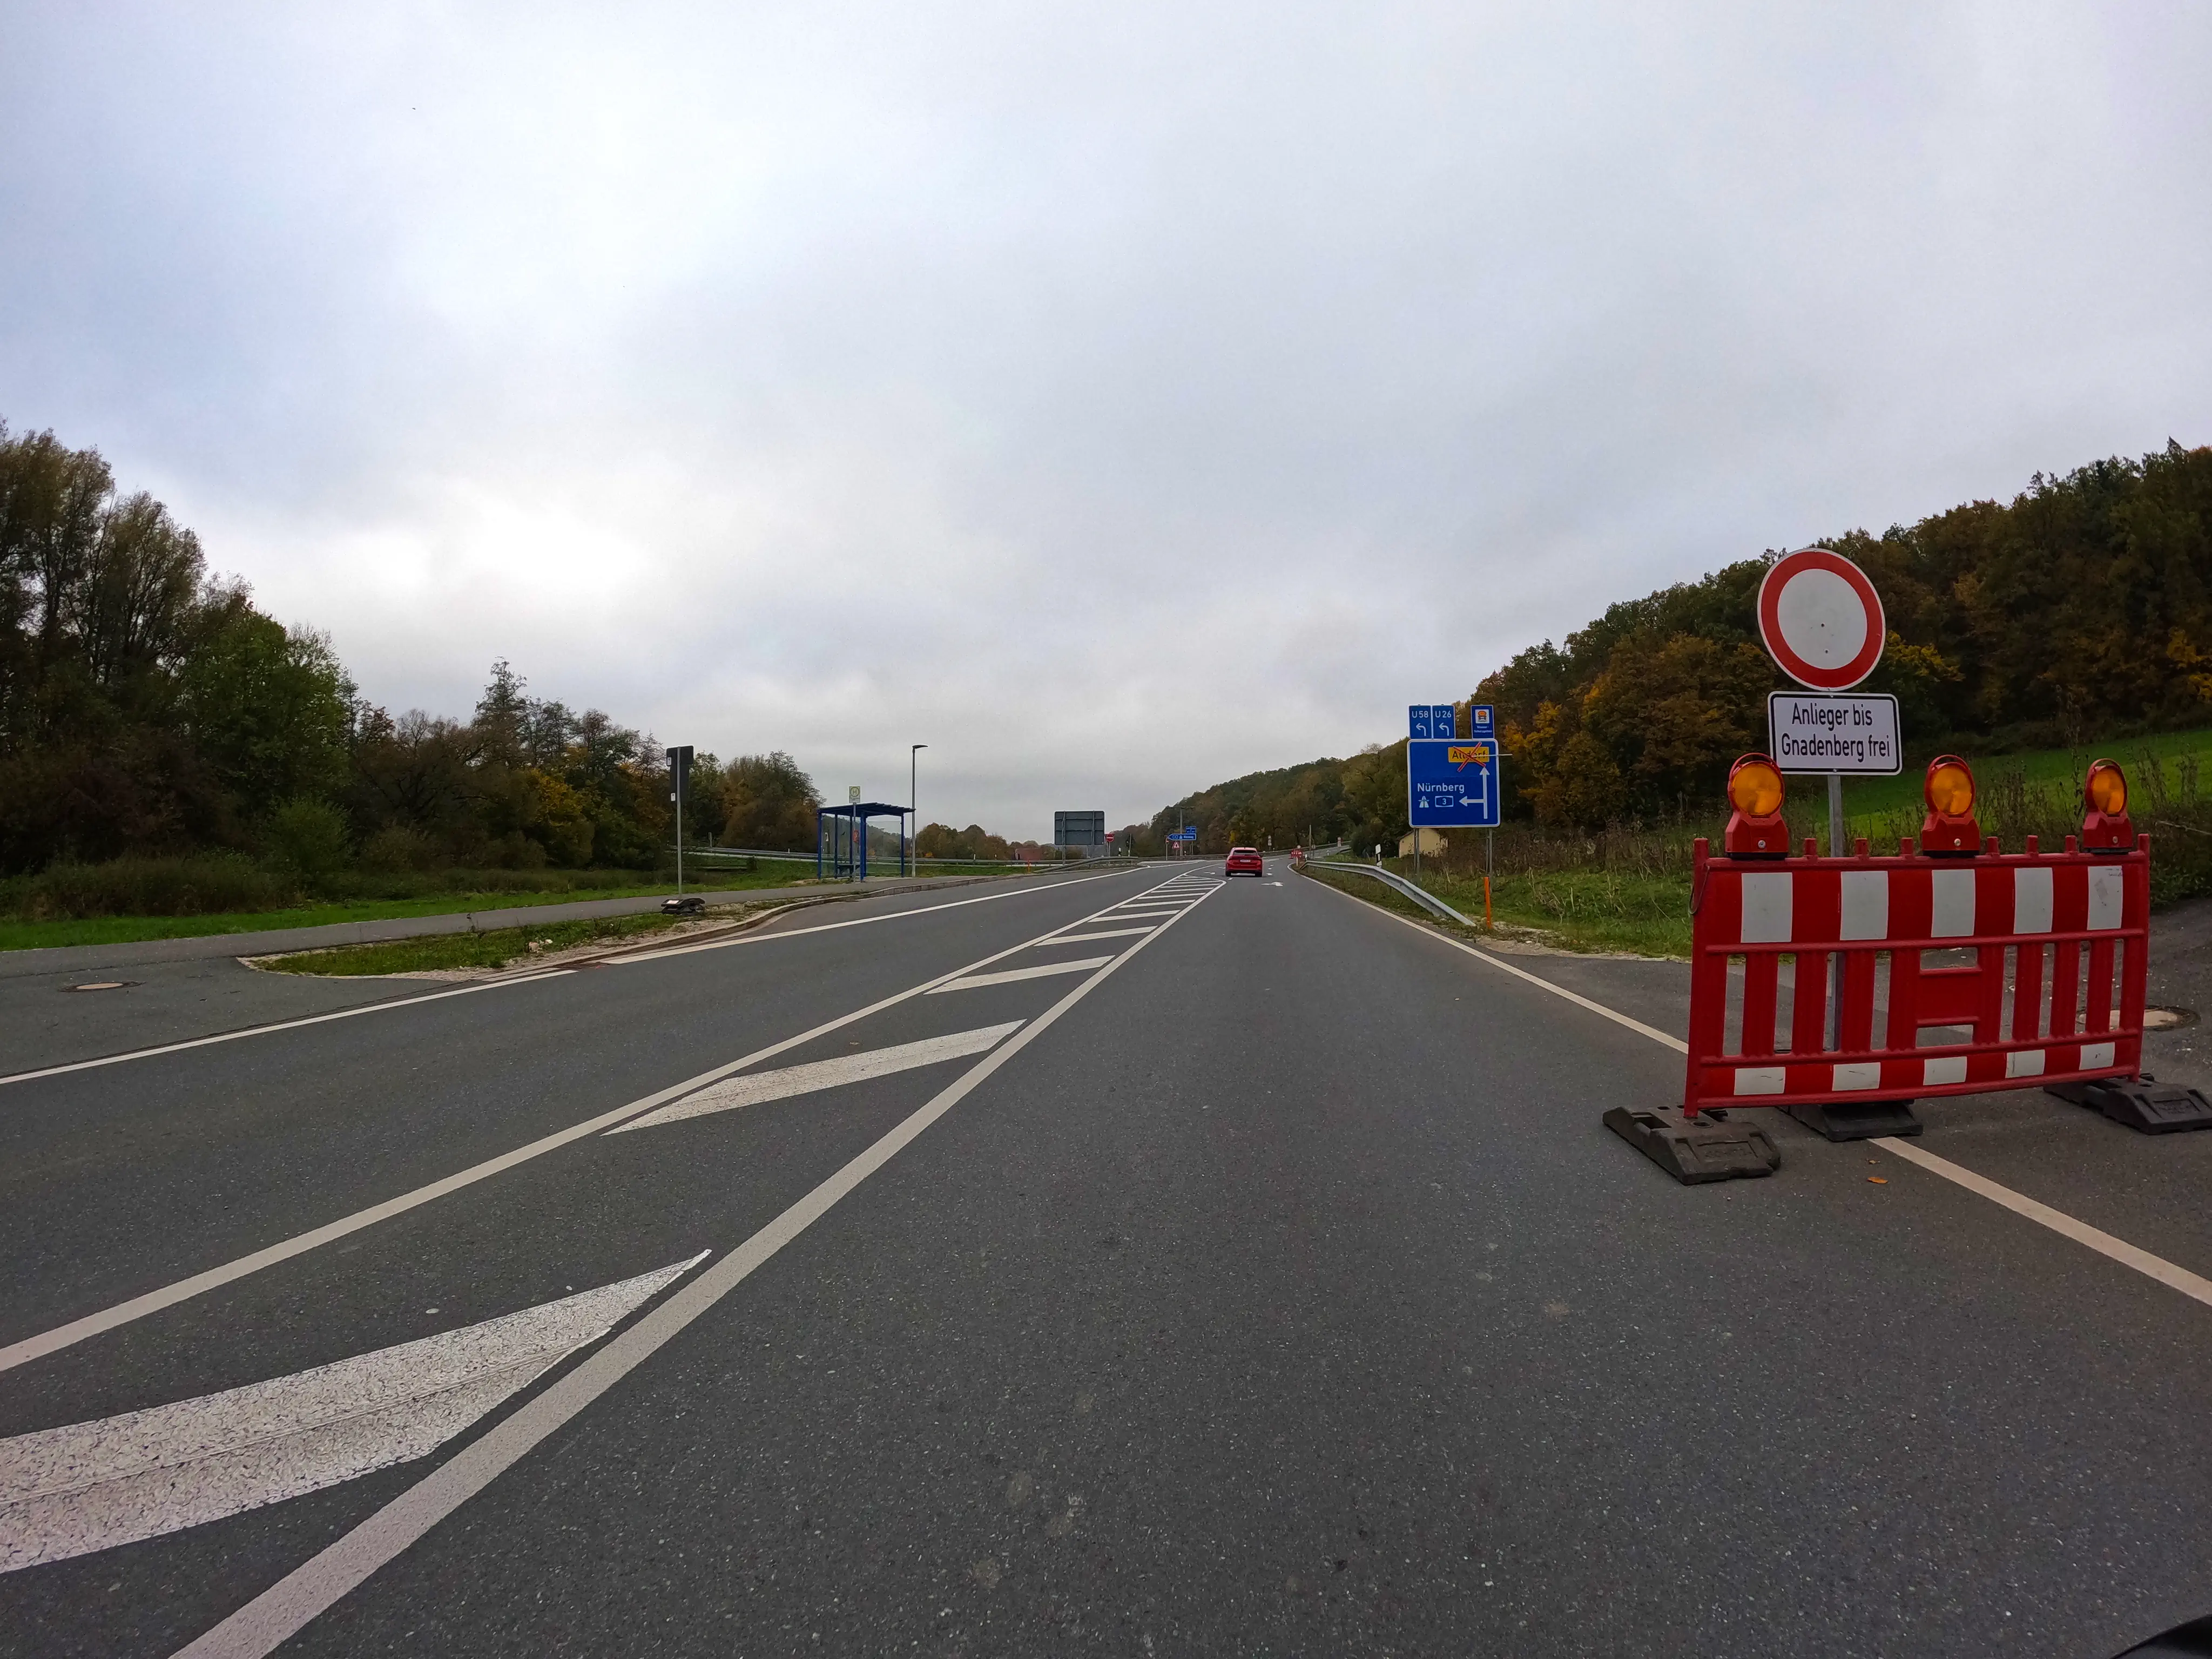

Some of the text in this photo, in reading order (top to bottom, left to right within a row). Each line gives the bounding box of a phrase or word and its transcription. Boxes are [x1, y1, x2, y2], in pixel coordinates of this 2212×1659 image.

[1792, 702, 1872, 731] Anlieger bis
[1782, 733, 1890, 763] Gnadenberg frei
[1417, 783, 1465, 793] Nürnberg
